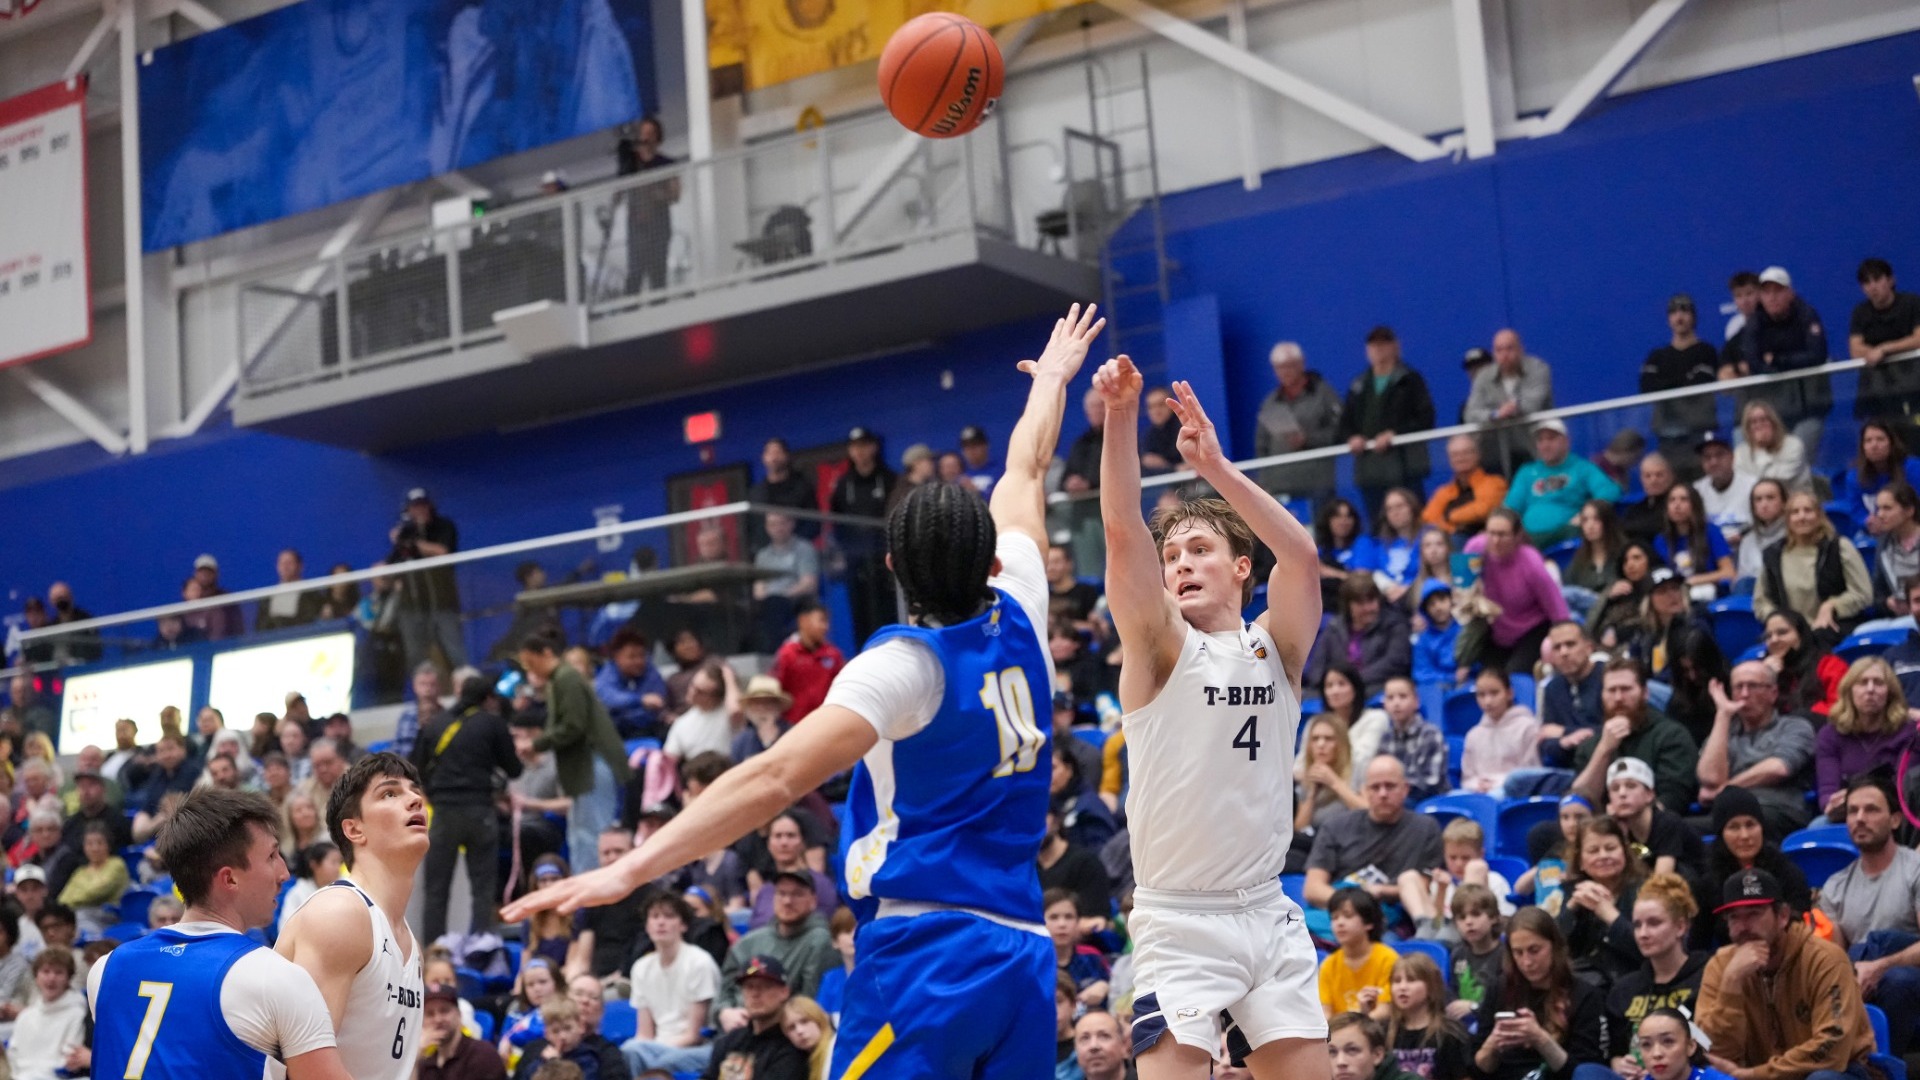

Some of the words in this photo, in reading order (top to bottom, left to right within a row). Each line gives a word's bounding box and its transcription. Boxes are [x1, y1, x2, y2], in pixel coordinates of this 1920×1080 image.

[930, 66, 981, 134] Wilson
[1204, 681, 1276, 706] T-BIRD
[979, 666, 1046, 777] 10
[1232, 715, 1260, 761] 4
[387, 983, 421, 1008] T-BIDS
[123, 981, 174, 1080] 7
[391, 1016, 406, 1060] 6
